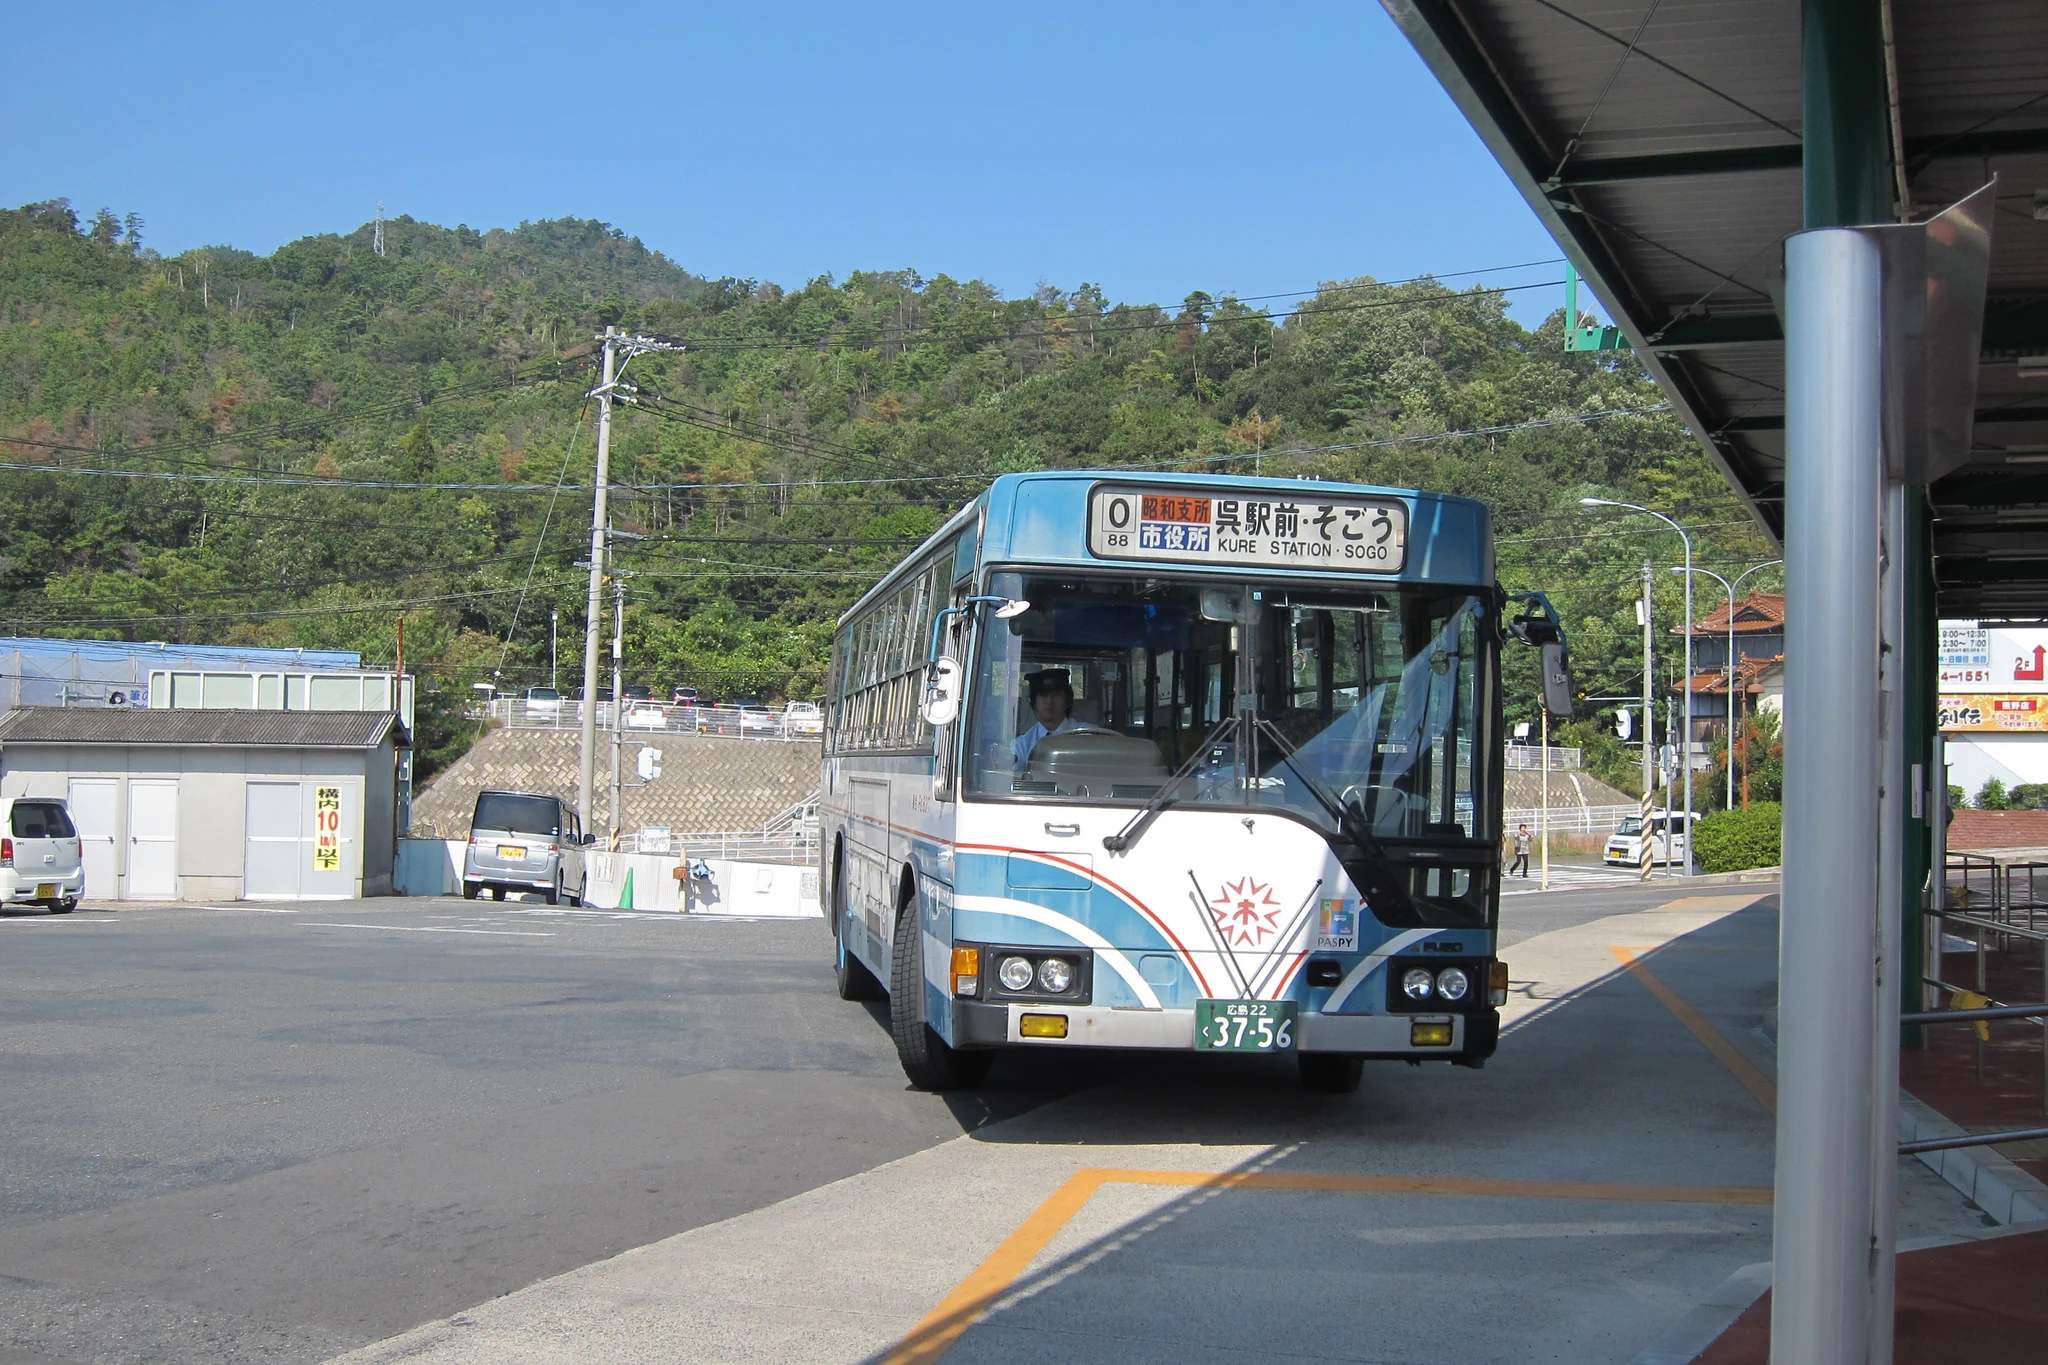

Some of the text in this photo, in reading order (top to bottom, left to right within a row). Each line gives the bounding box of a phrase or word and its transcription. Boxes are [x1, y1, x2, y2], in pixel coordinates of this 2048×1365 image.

[1109, 498, 1130, 528] 0
[1143, 497, 1209, 522] 昭和支所
[1215, 500, 1393, 545] 呉駅前・そごう
[1108, 534, 1128, 547] 88
[1142, 524, 1208, 550] 市役所
[1218, 538, 1388, 560] KURE STATION SOGO
[1317, 937, 1353, 948] PASPY
[1212, 1016, 1292, 1048] 37-56
